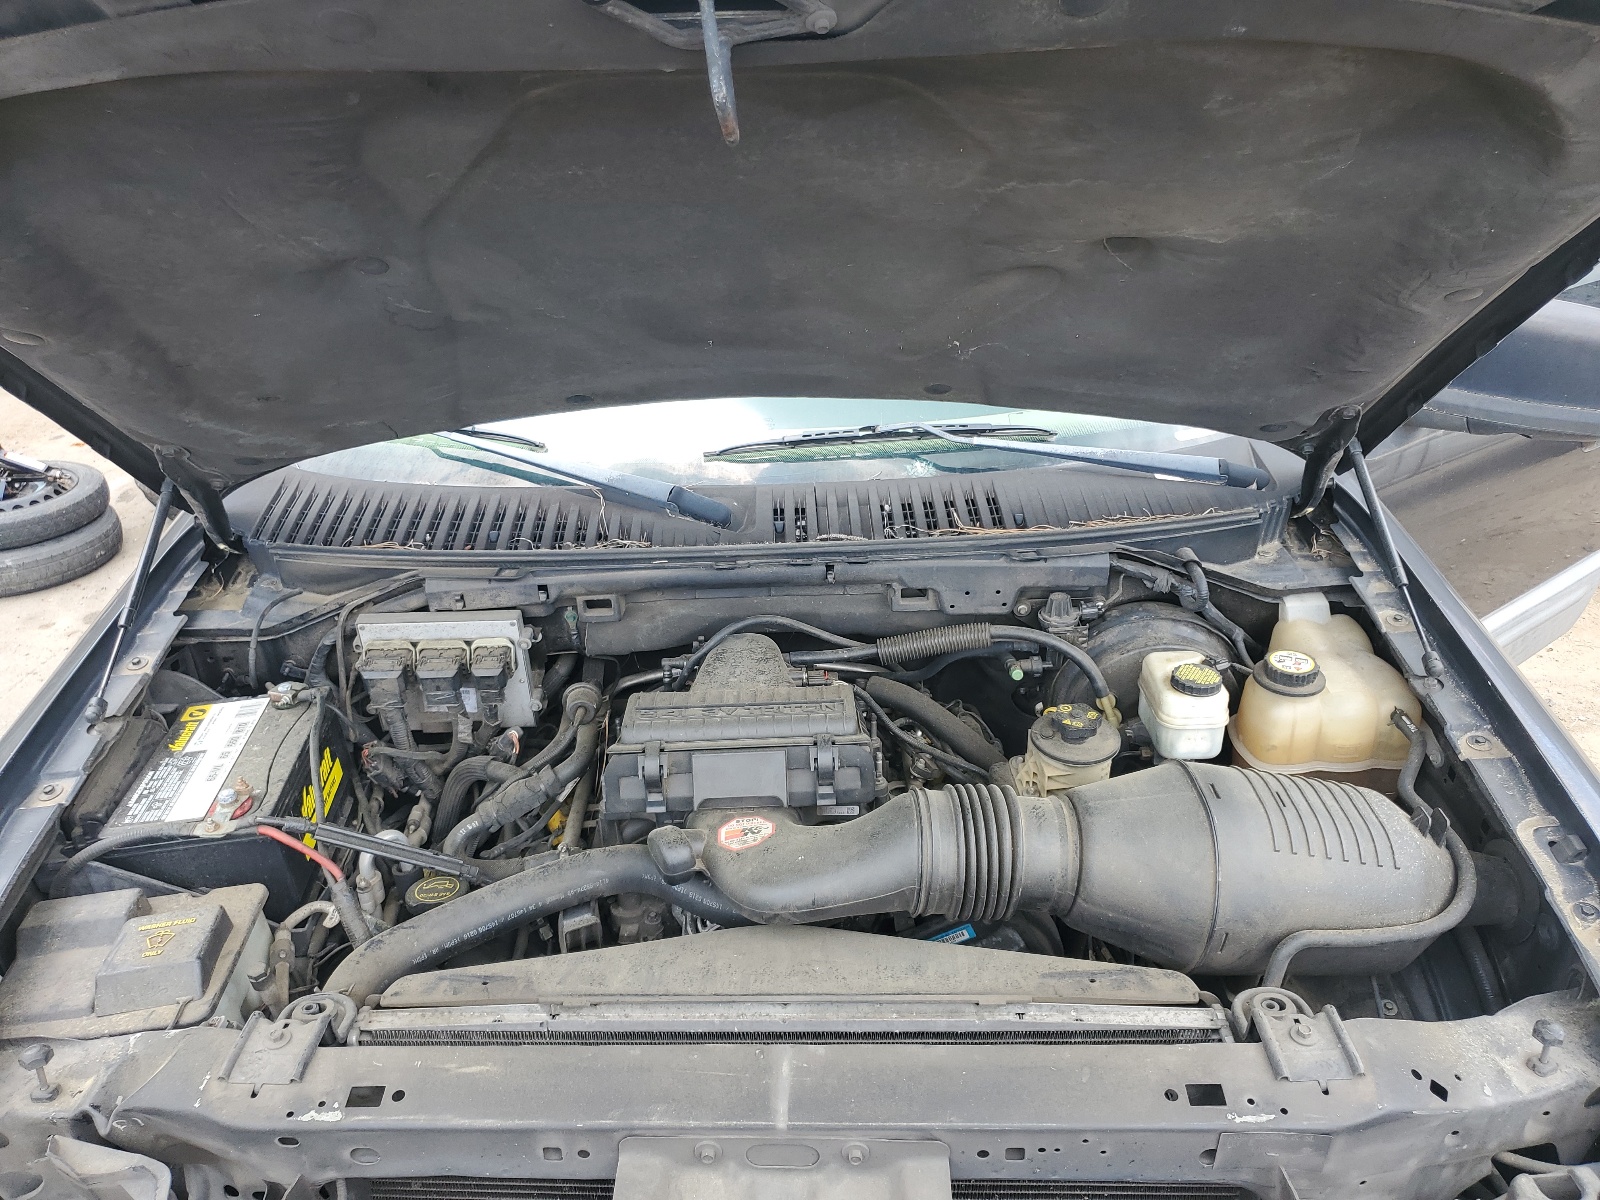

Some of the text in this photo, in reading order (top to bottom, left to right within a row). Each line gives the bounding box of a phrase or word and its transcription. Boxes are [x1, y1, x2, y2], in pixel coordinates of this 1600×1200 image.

[168, 721, 200, 752] Valucraft
[138, 917, 197, 931] WASHER FLUID
[142, 949, 164, 958] ONLY
